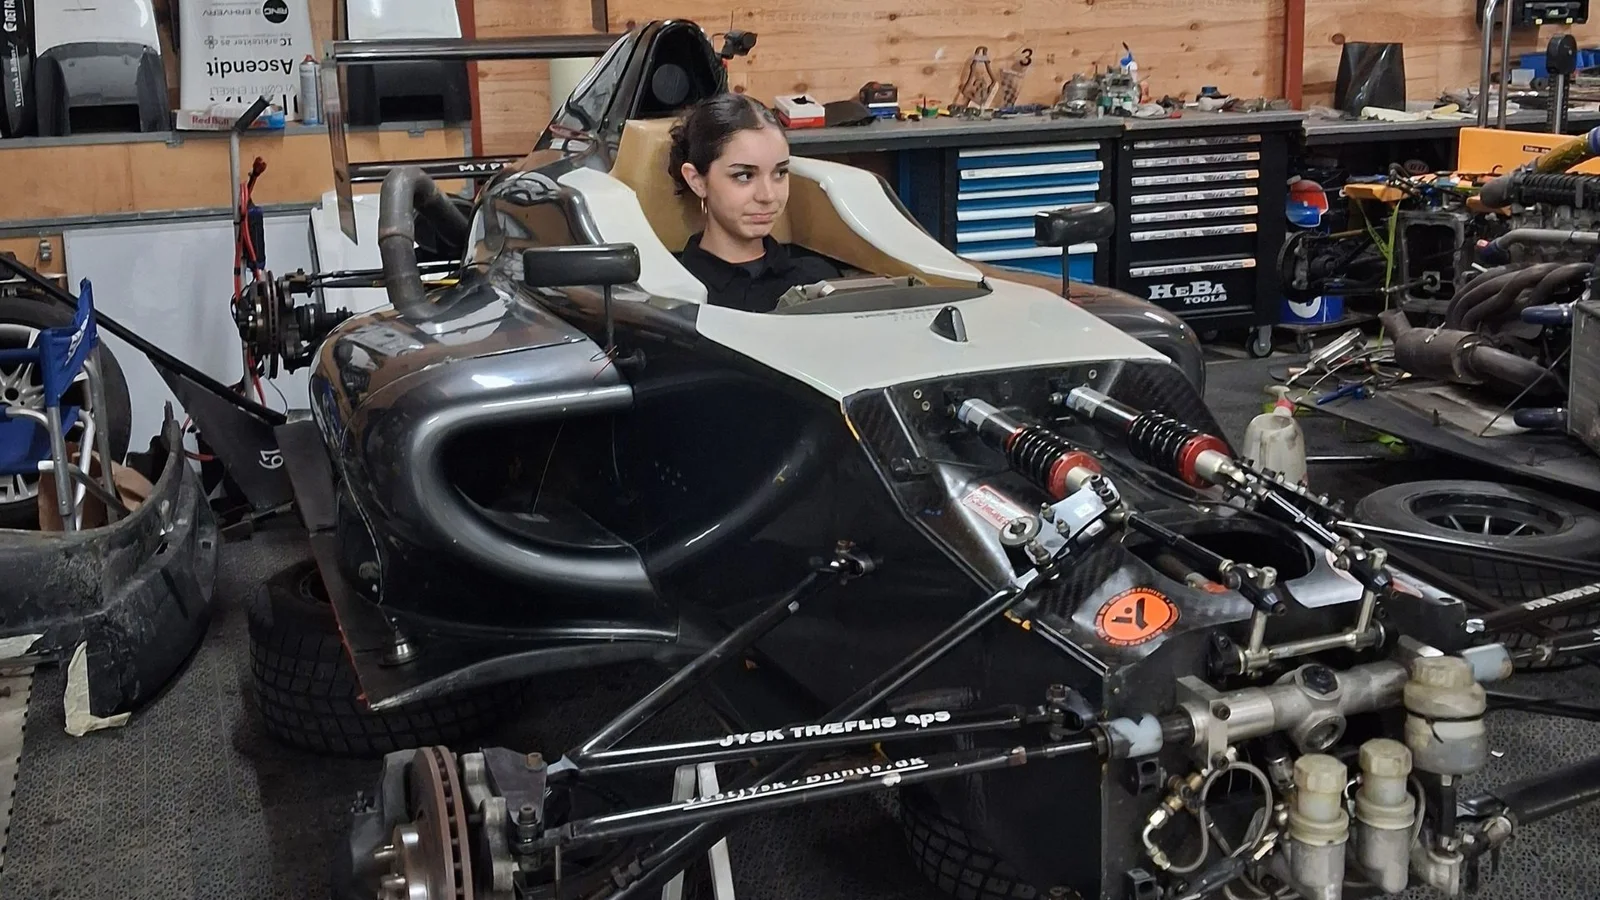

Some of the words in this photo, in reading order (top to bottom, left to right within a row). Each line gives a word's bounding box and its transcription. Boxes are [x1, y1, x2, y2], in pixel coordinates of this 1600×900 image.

[4, 9, 17, 22] DET
[234, 38, 278, 47] arkitekter
[280, 38, 292, 47] IC
[1020, 48, 1033, 66] 3
[191, 115, 211, 124] Red
[1183, 294, 1228, 304] TOOLS
[258, 448, 285, 470] 67
[719, 729, 785, 747] JYSK
[789, 715, 897, 738] TRÆFLIS
